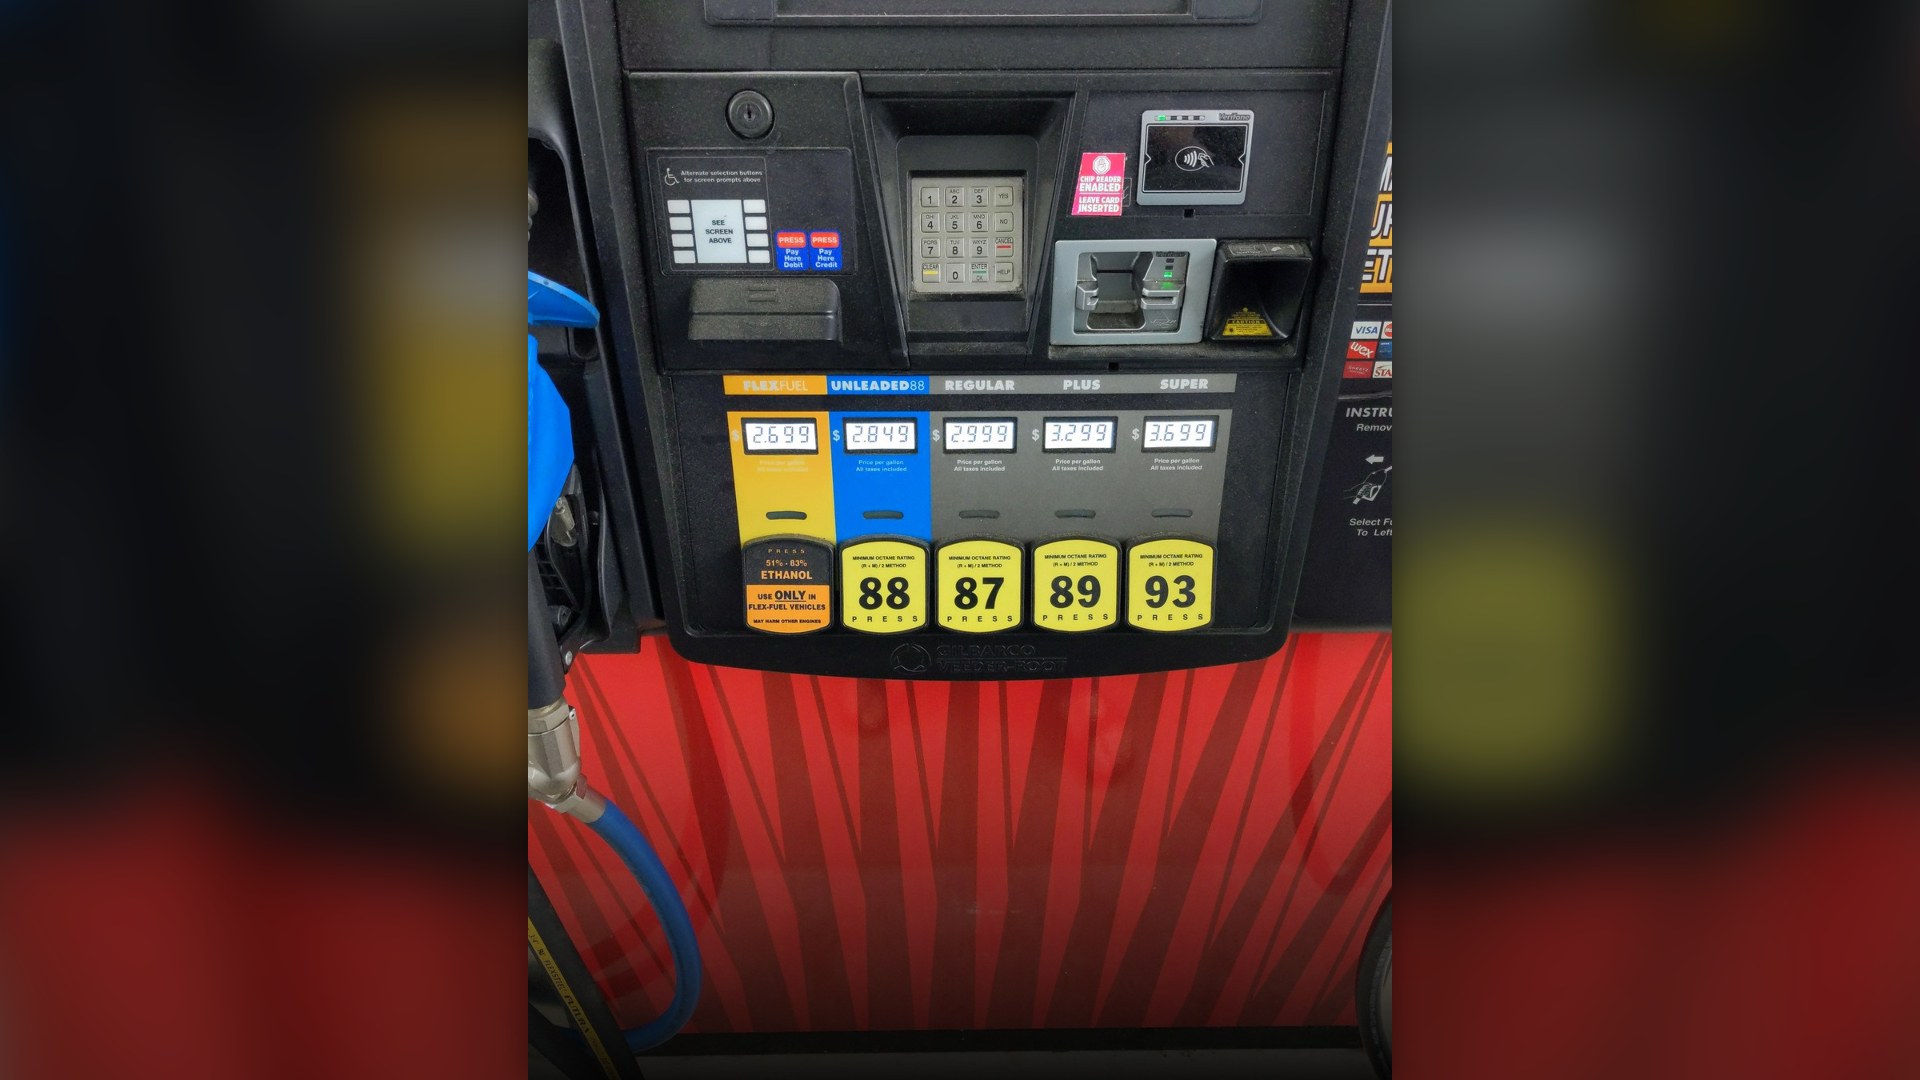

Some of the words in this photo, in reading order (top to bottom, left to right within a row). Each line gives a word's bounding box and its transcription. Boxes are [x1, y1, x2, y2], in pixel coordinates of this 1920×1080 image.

[1080, 182, 1121, 192] ENABLED
[928, 195, 932, 204] 1
[951, 195, 958, 204] 2
[976, 195, 983, 204] 3
[1078, 203, 1119, 213] INSERTED
[927, 221, 934, 229] 4
[952, 221, 958, 229] 5
[976, 221, 983, 229] 6
[779, 236, 804, 244] PRESS
[812, 236, 837, 244] PRESS
[785, 248, 799, 256] Pay
[818, 248, 832, 256] Pay
[927, 246, 934, 255] 7
[952, 246, 958, 255] 8
[976, 246, 983, 255] 9
[952, 271, 959, 280] 0
[1356, 326, 1378, 334] VISA
[945, 380, 1015, 391] REGULAR
[1063, 379, 1101, 390] PLUS
[1160, 378, 1208, 390] SUPER
[753, 426, 809, 443] 2.699
[852, 425, 909, 443] 2.849
[951, 425, 1008, 443] 2.999
[1050, 424, 1107, 442] 3.299
[1149, 423, 1207, 442] 3.699
[1082, 458, 1101, 466] gallon
[1181, 457, 1200, 465] gallon
[1349, 518, 1380, 526] Select
[761, 570, 813, 580] ETHANOL
[774, 590, 806, 601] ONLY
[859, 577, 910, 610] 88
[954, 577, 1005, 610] 87
[1050, 575, 1101, 609] 89
[1145, 575, 1196, 609] 93
